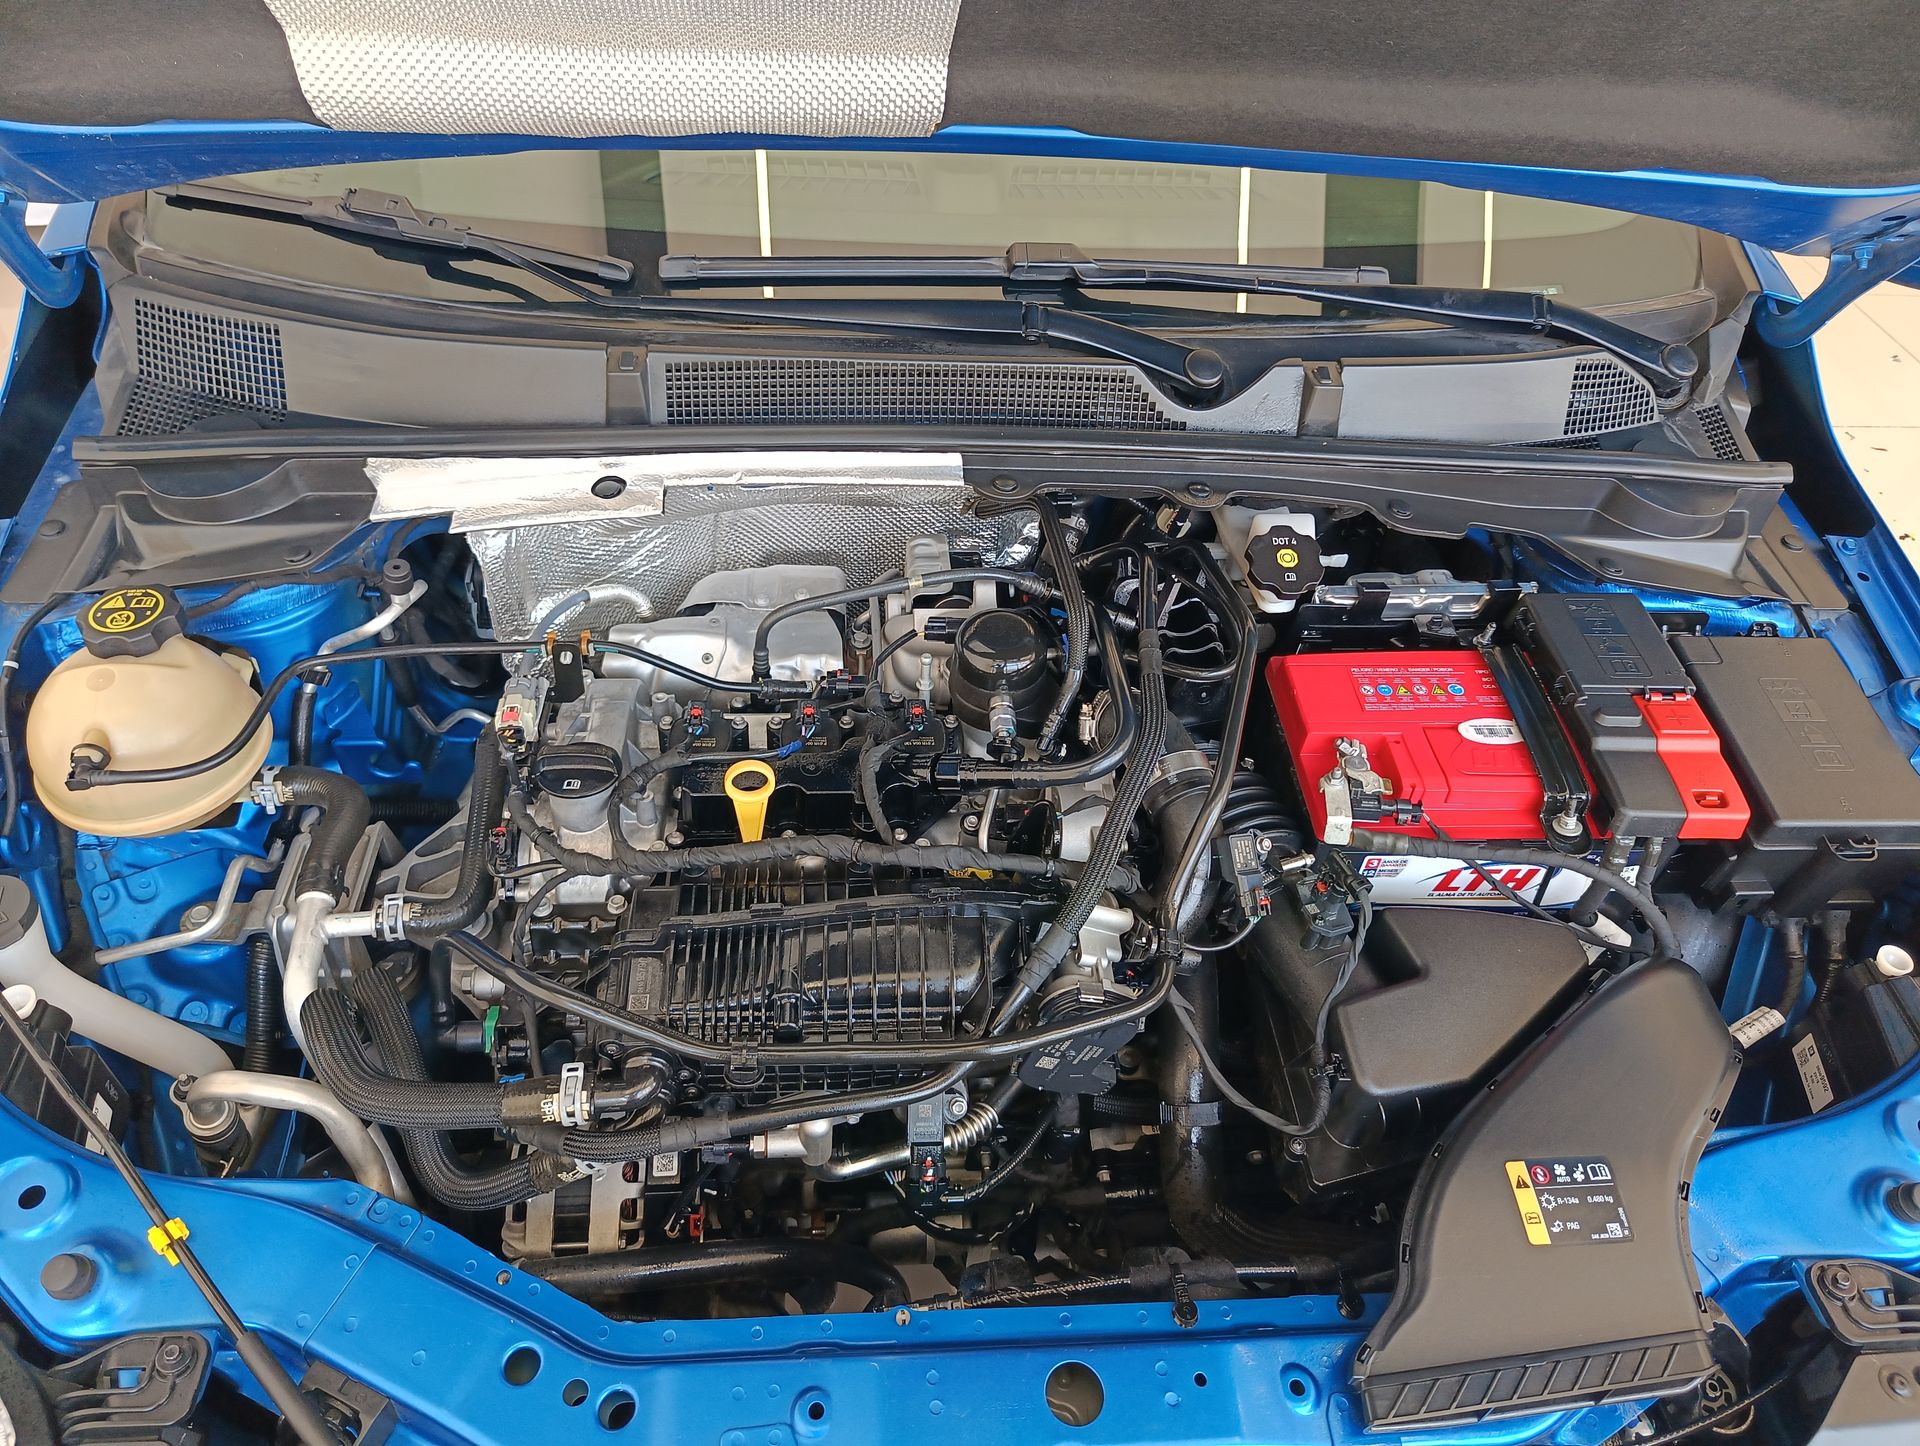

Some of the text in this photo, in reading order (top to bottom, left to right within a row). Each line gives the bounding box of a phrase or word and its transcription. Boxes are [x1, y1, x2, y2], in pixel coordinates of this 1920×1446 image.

[1272, 537, 1297, 545] DOT 4
[1368, 860, 1379, 868] 3
[1362, 869, 1376, 877] 12
[1431, 868, 1541, 892] LTH
[1557, 1196, 1580, 1205] R-134a
[1604, 1194, 1614, 1204] kg
[1566, 1221, 1580, 1230] PAG
